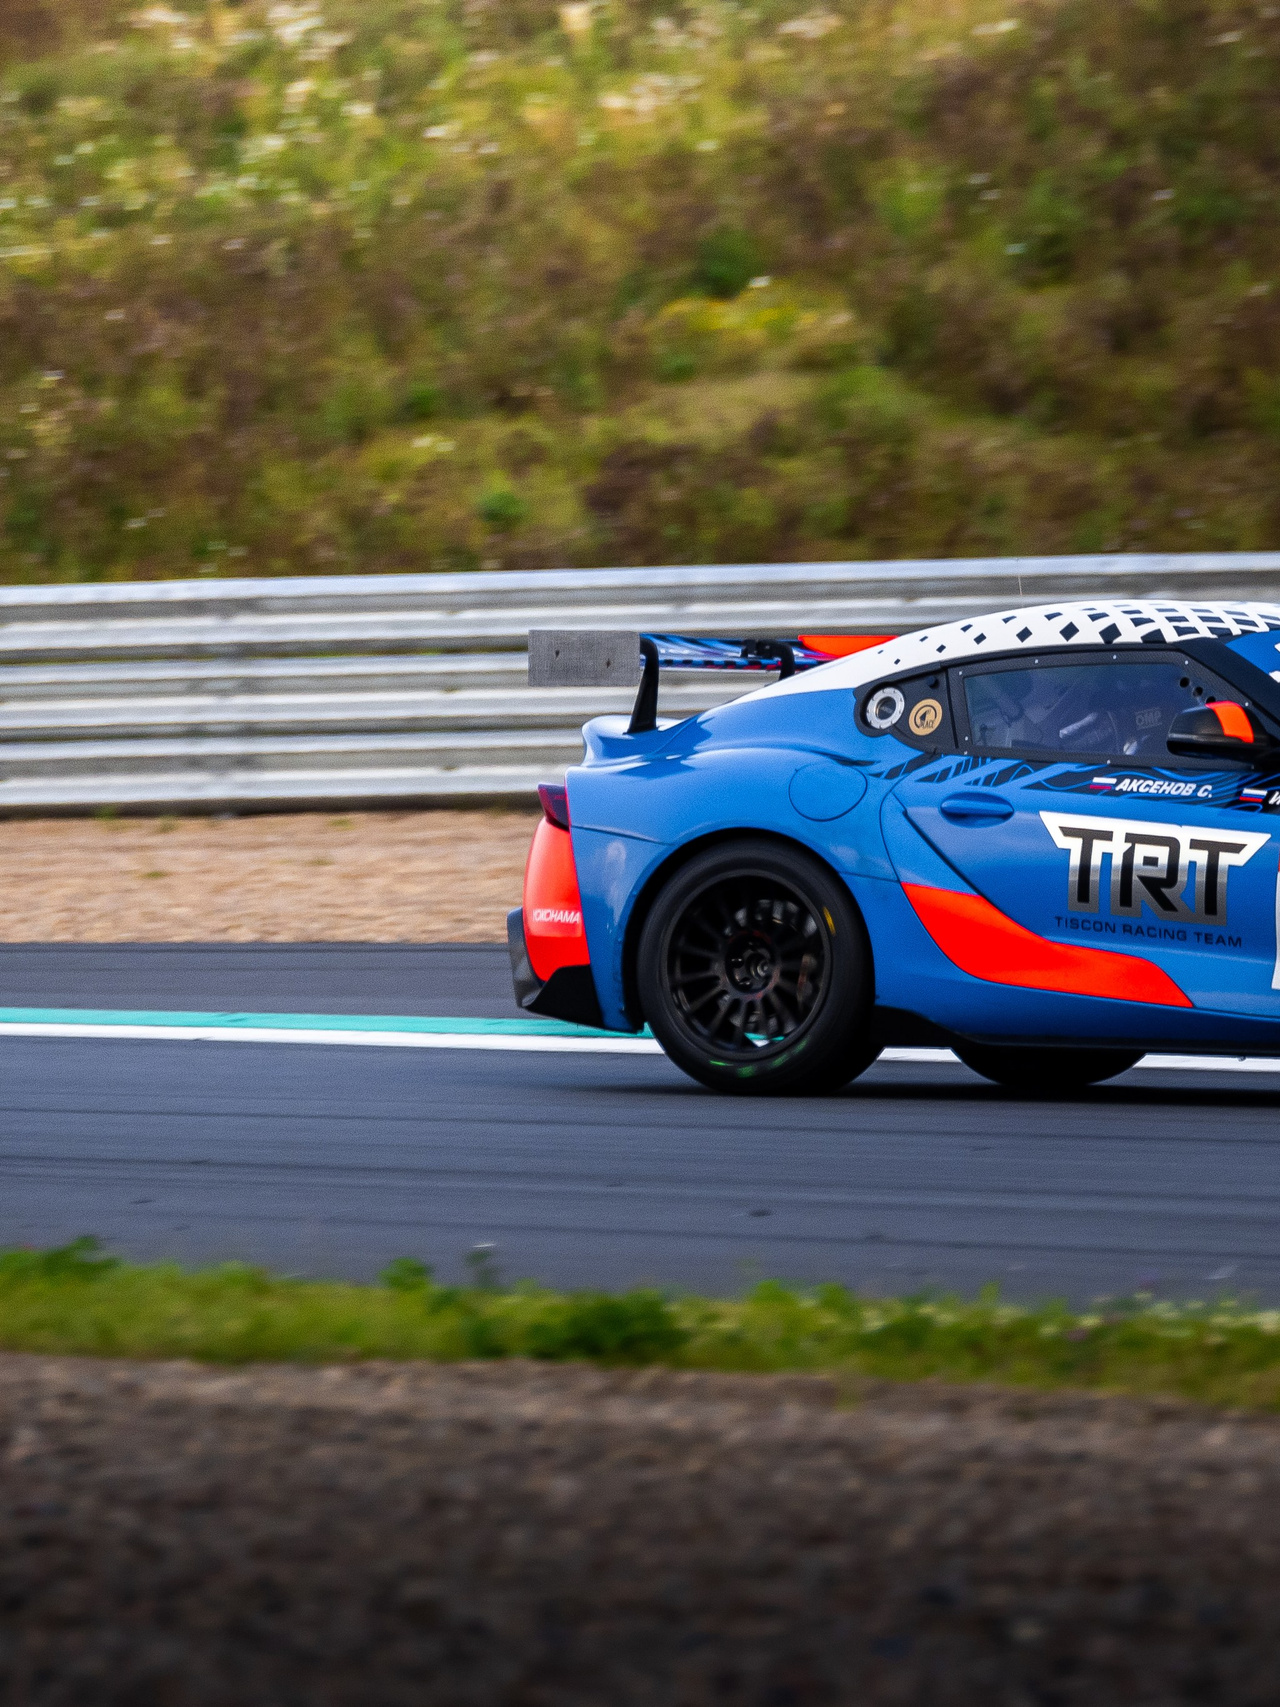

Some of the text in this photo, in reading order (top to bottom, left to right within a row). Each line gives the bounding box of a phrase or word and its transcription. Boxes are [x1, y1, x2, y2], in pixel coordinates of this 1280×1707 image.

[1115, 778, 1197, 797] АКСЕНОВ
[1043, 814, 1265, 924] TRT
[1054, 915, 1243, 948] TISCON RACING TEAM
